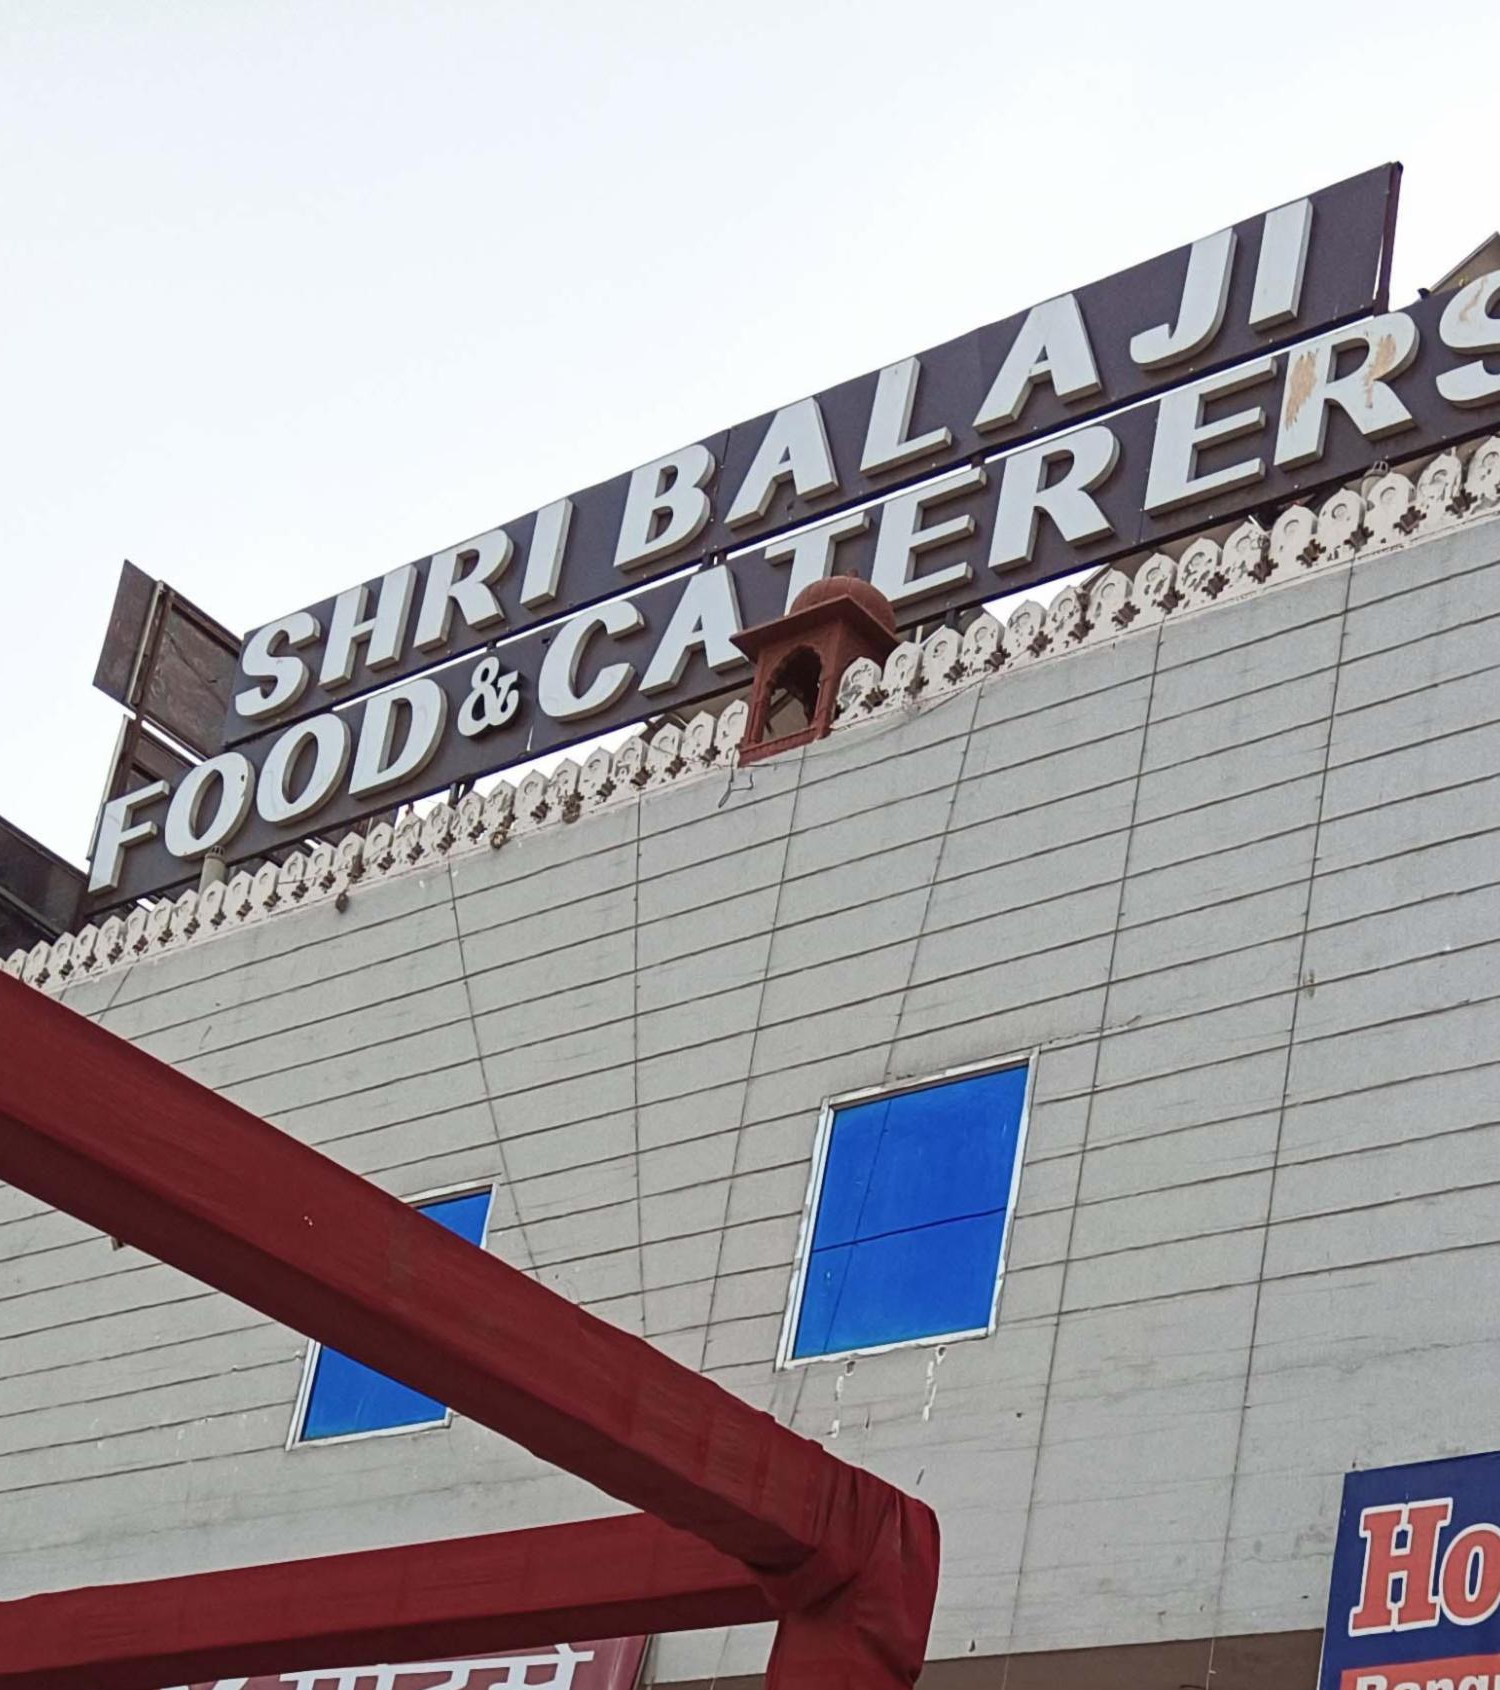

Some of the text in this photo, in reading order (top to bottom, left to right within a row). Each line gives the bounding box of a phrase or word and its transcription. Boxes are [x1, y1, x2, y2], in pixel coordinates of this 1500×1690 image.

[233, 197, 1314, 722] SHRI BALAJI
[88, 679, 446, 894] FOOD
[459, 656, 520, 740] &
